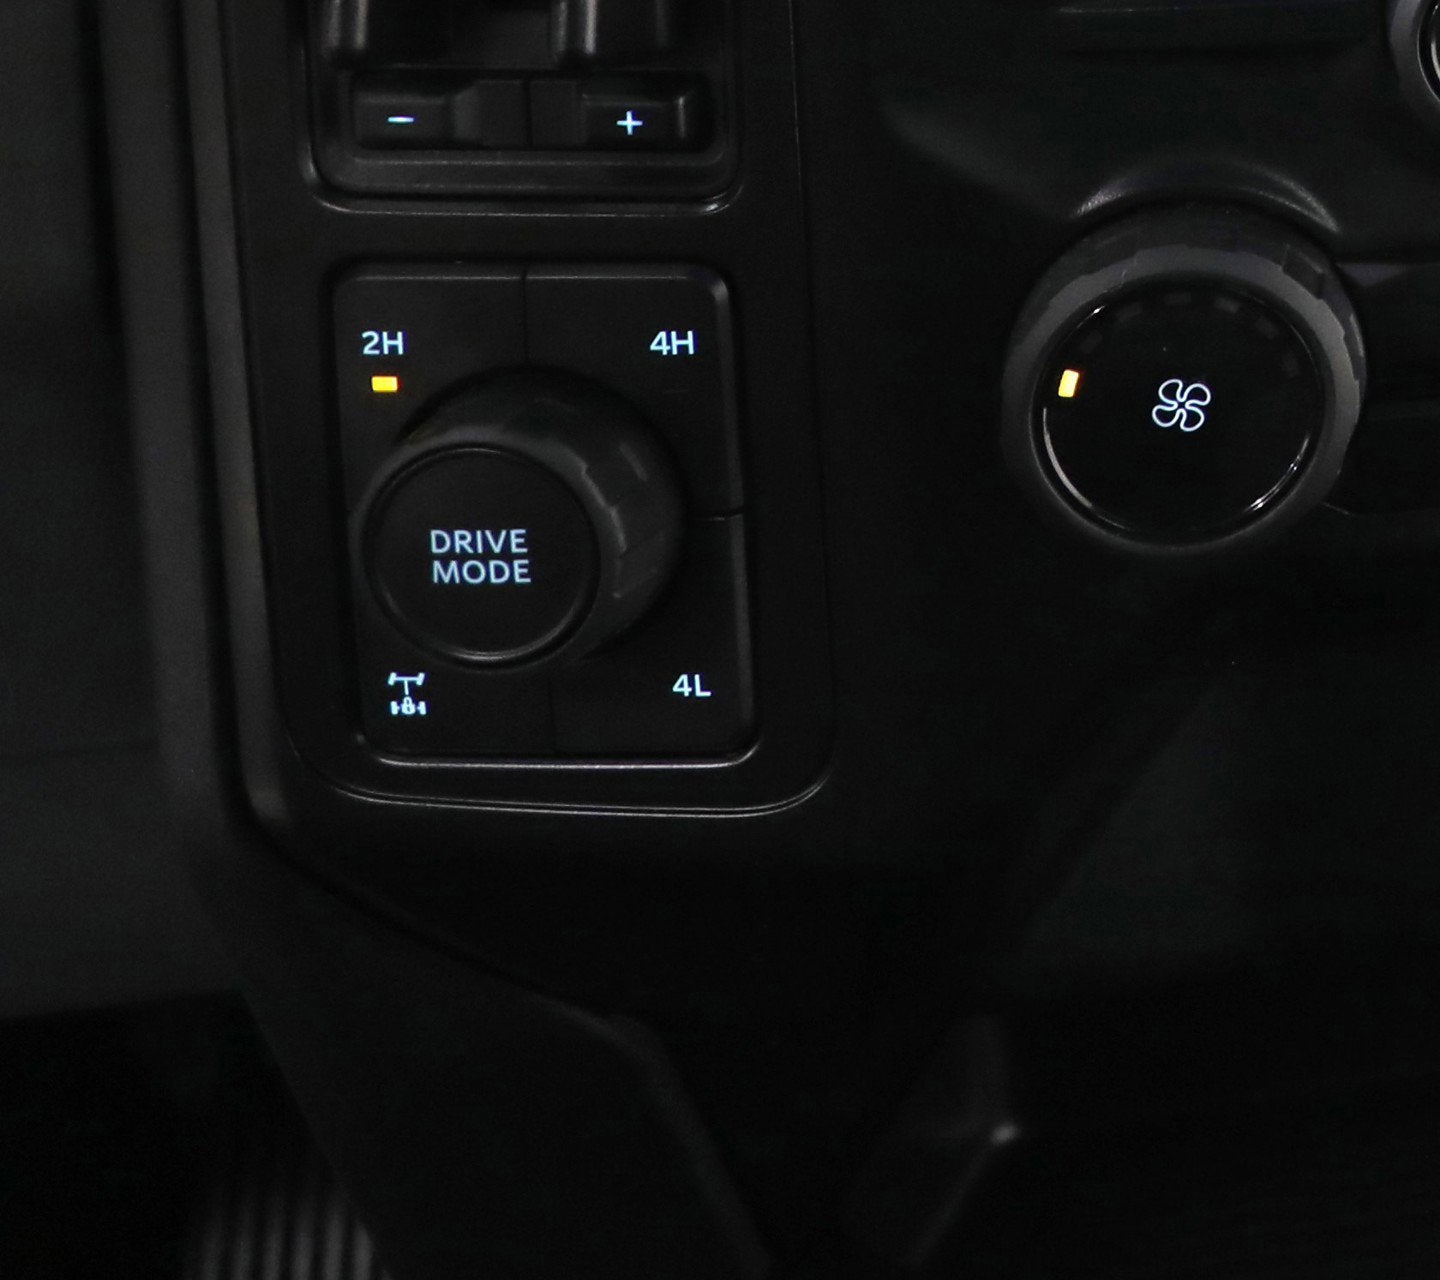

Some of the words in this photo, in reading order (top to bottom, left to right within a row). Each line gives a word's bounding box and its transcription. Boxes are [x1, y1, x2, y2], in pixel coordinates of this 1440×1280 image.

[361, 330, 404, 355] 2H
[649, 330, 695, 356] 4H
[430, 528, 528, 554] DRIVE
[433, 559, 531, 584] MODE
[672, 673, 712, 697] 4L
